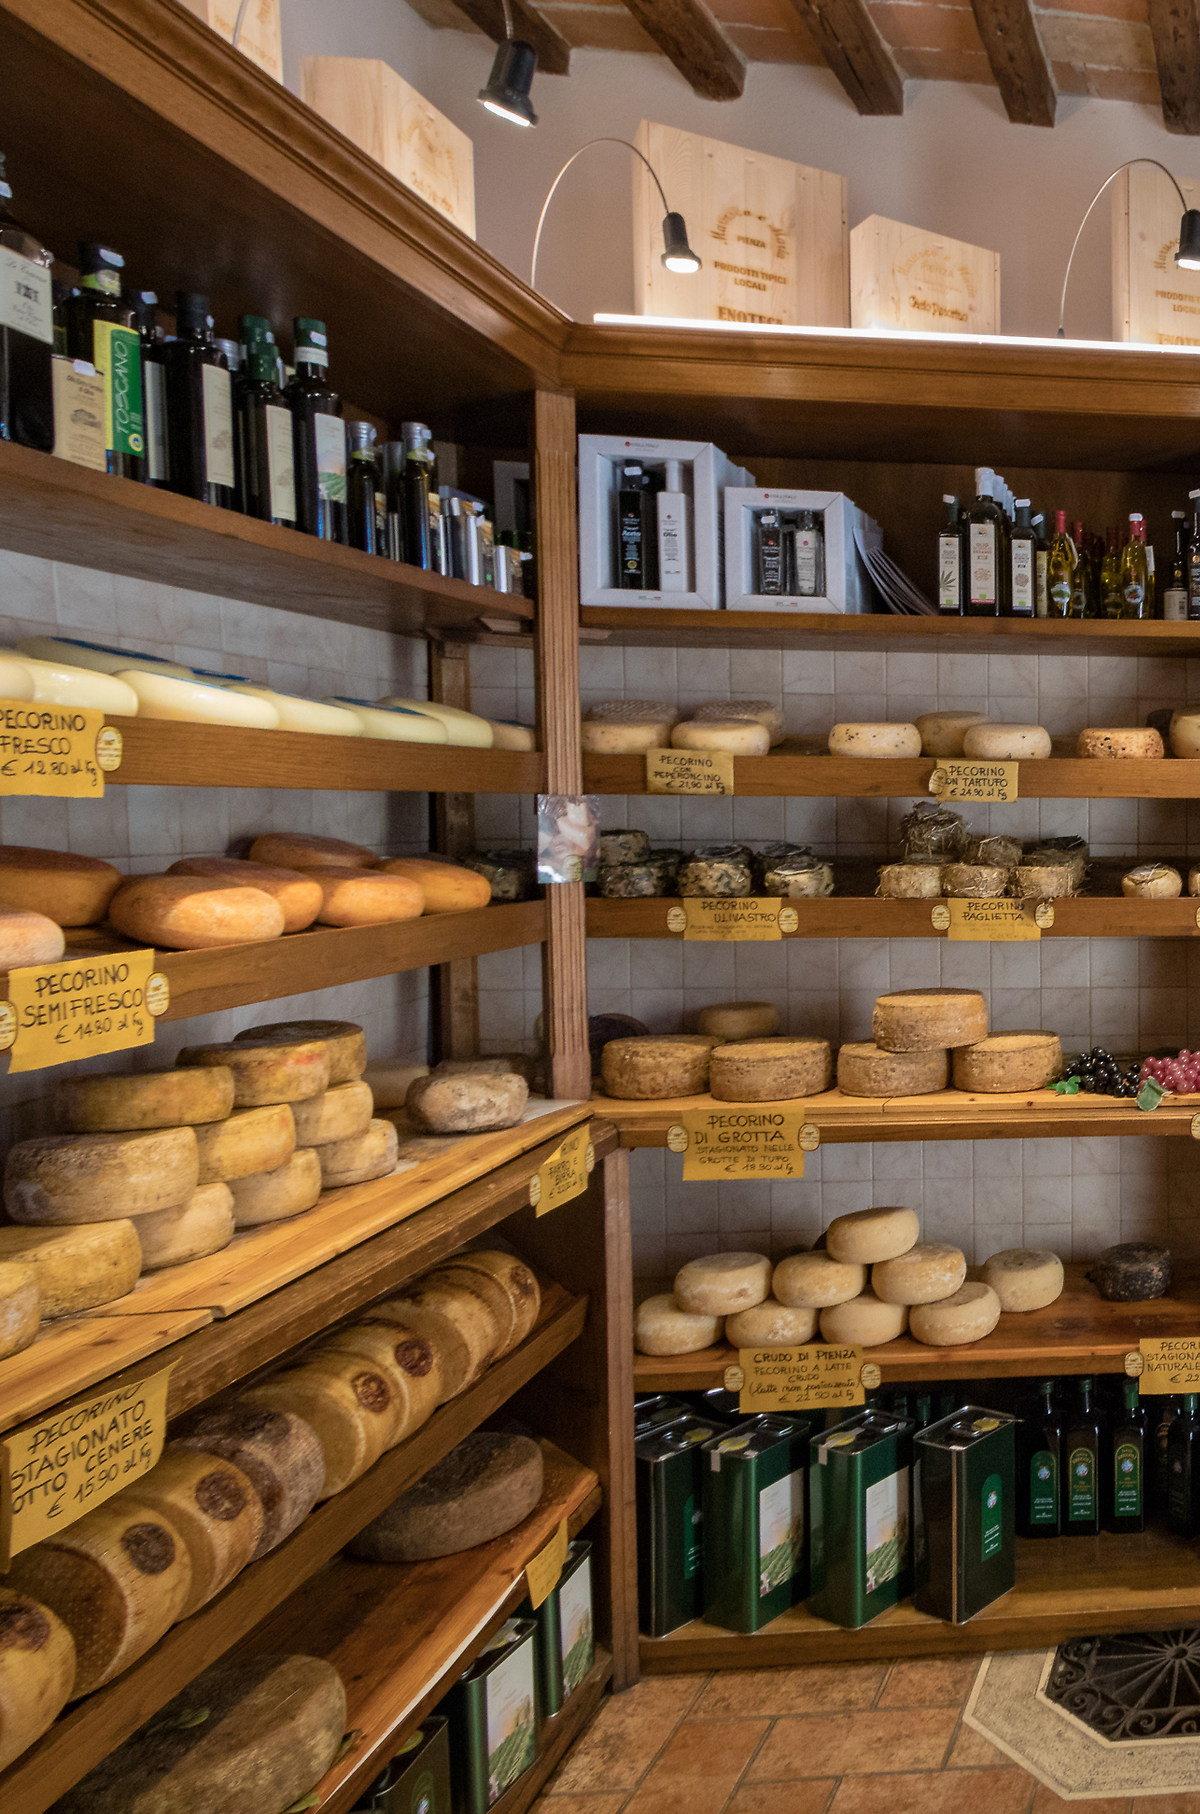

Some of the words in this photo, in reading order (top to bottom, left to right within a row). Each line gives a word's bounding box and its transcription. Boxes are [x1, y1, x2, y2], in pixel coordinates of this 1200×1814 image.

[737, 235, 767, 249] PIENZA
[714, 261, 759, 278] PRODOTTI
[760, 271, 788, 285] TIPICI
[734, 278, 767, 292] LOCALI
[114, 340, 130, 434] TOSCANO
[0, 736, 71, 755] FRESCO
[1, 759, 18, 776] €
[659, 755, 713, 768] PECORINO
[653, 771, 721, 782] PEPERONCINO
[949, 765, 1006, 777] PECORINO
[962, 778, 1009, 788] TARTUFO
[950, 788, 959, 796] €
[701, 901, 759, 911] PECORINO
[966, 902, 1025, 912] PECORINO
[962, 912, 1024, 921] PAGLIETTA
[34, 963, 129, 998] PECORINO
[20, 988, 144, 1028] SEMIFRESCO
[54, 1025, 72, 1044] €
[707, 1114, 785, 1129] PECORINO
[694, 1131, 708, 1144] DI
[718, 1131, 785, 1143] GROTTA
[764, 1144, 795, 1152] NELLE
[699, 1156, 740, 1164] GROTTE
[725, 1163, 737, 1173] €
[753, 1352, 793, 1363] CRUDO
[797, 1352, 809, 1361] DI
[815, 1350, 857, 1361] PIENZA
[754, 1364, 808, 1376] PECORINO
[813, 1364, 820, 1372] A
[824, 1362, 852, 1371] LATTE
[788, 1374, 820, 1383] CRUDO
[1169, 1373, 1181, 1383] €
[778, 1394, 791, 1403] €
[27, 1382, 146, 1455] PECORINO
[11, 1400, 146, 1494] STAGIONATO
[85, 1419, 153, 1473] CENERE
[46, 1492, 67, 1519] €
